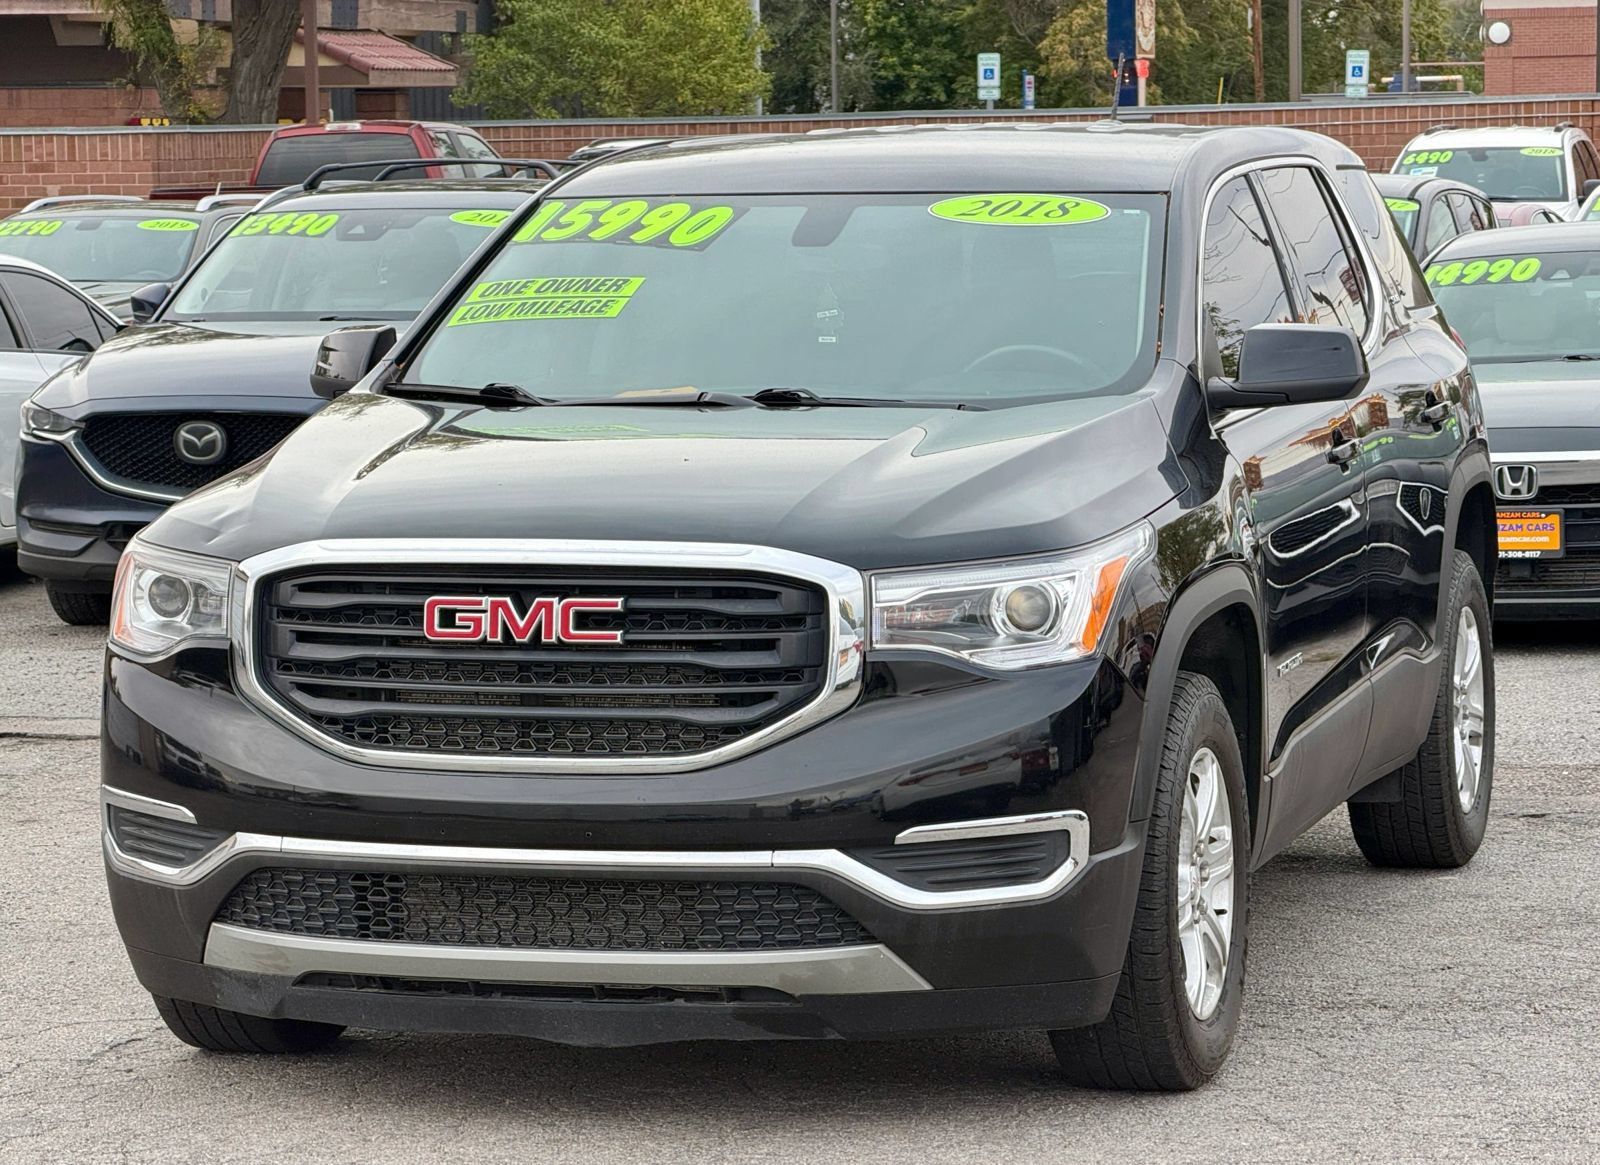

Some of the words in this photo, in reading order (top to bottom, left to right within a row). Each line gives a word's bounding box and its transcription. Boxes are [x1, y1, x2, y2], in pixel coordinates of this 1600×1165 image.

[463, 212, 510, 224] 201
[953, 199, 1081, 219] 2018
[512, 200, 735, 247] 15990
[478, 280, 535, 298] ONE
[535, 278, 632, 296] OWNER
[457, 303, 513, 323] LOW
[510, 300, 617, 317] MILEAGE
[1498, 523, 1523, 532] ZAM
[1526, 523, 1555, 532] CARS
[424, 595, 624, 644] GMC
